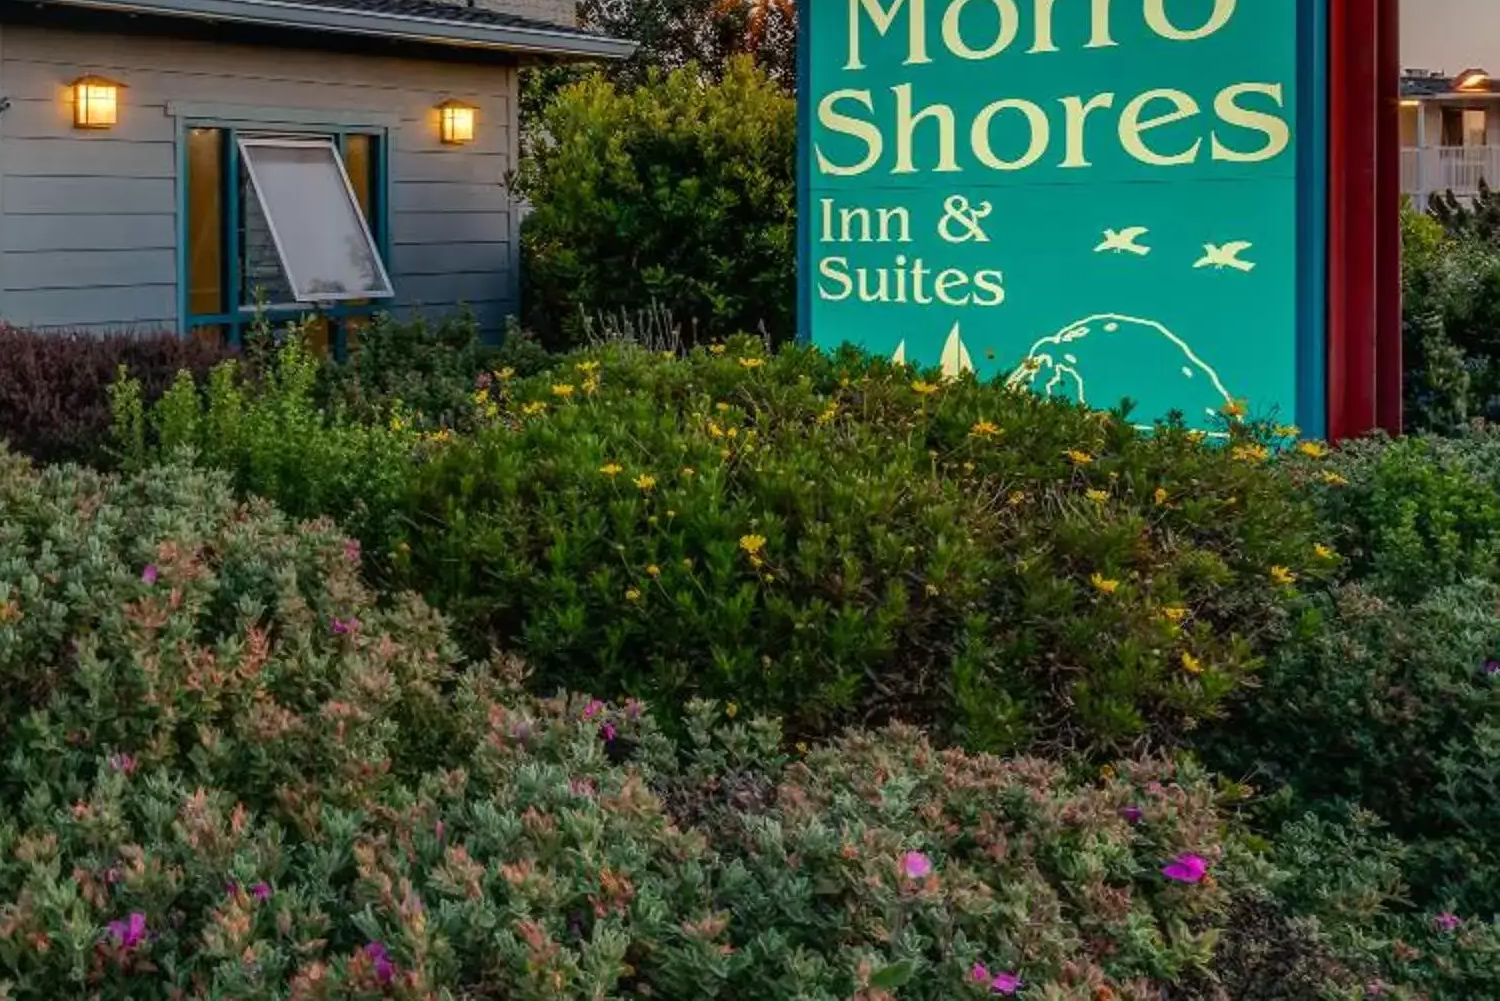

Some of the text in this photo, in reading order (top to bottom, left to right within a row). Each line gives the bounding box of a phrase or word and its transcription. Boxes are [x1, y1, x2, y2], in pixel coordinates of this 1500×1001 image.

[814, 82, 1290, 176] Shores
[819, 194, 993, 243] Inn &
[818, 255, 1005, 306] Suites
